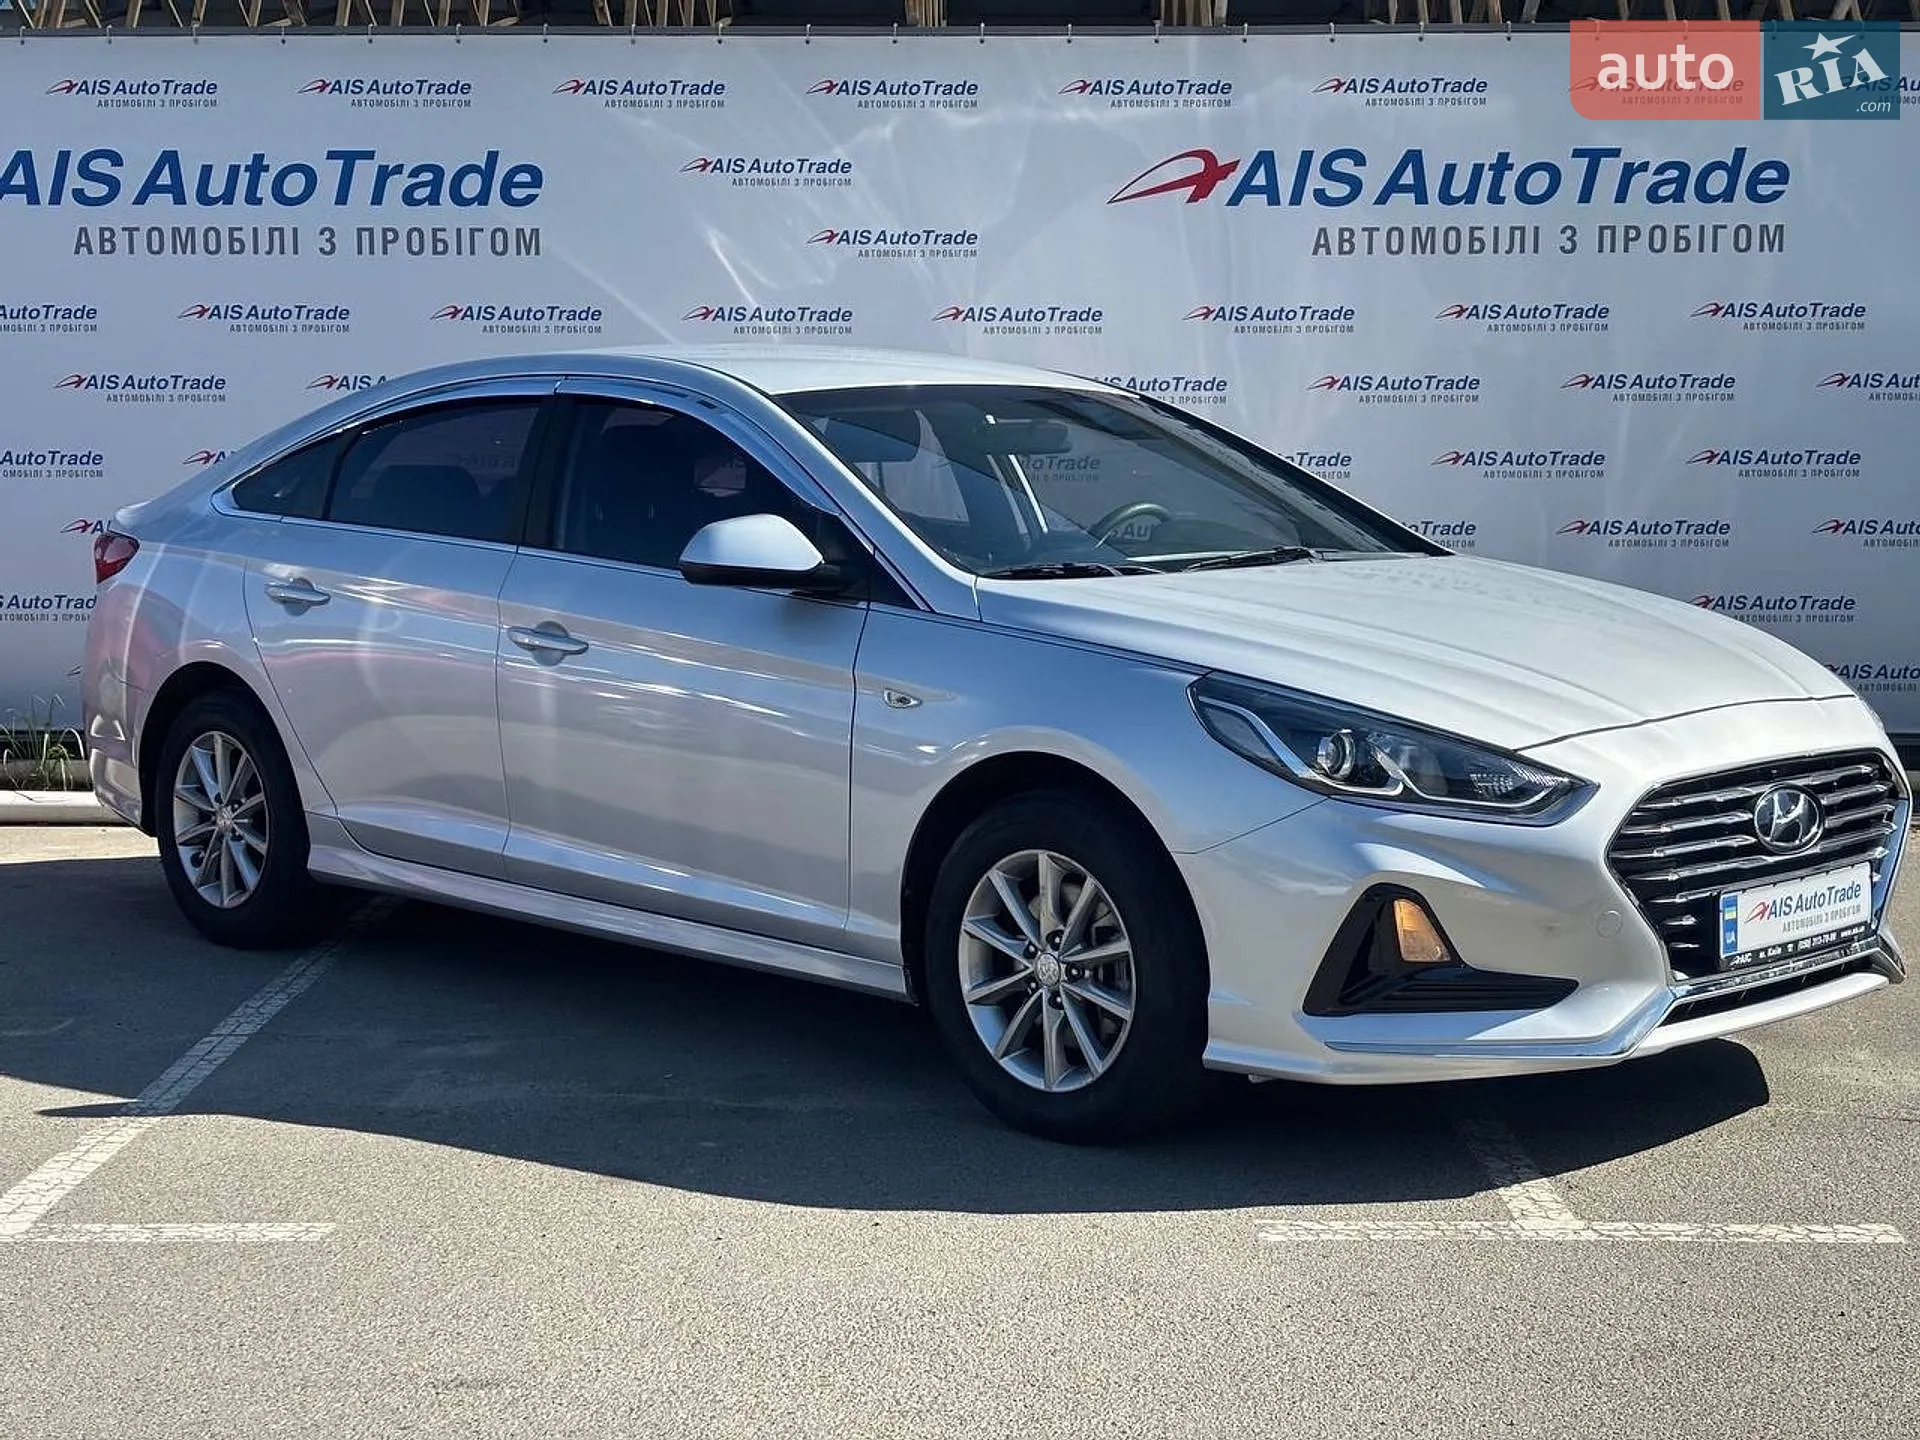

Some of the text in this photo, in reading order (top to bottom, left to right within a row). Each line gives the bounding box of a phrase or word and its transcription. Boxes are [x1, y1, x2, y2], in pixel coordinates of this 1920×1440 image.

[0, 150, 124, 207] AIS
[1224, 149, 1368, 207] AIS
[73, 226, 542, 257] АВТОМОБІЛІ З ПРОБІГОМ
[1311, 224, 1786, 257] АВТОМОБІЛІ З ПРОБІГОМ
